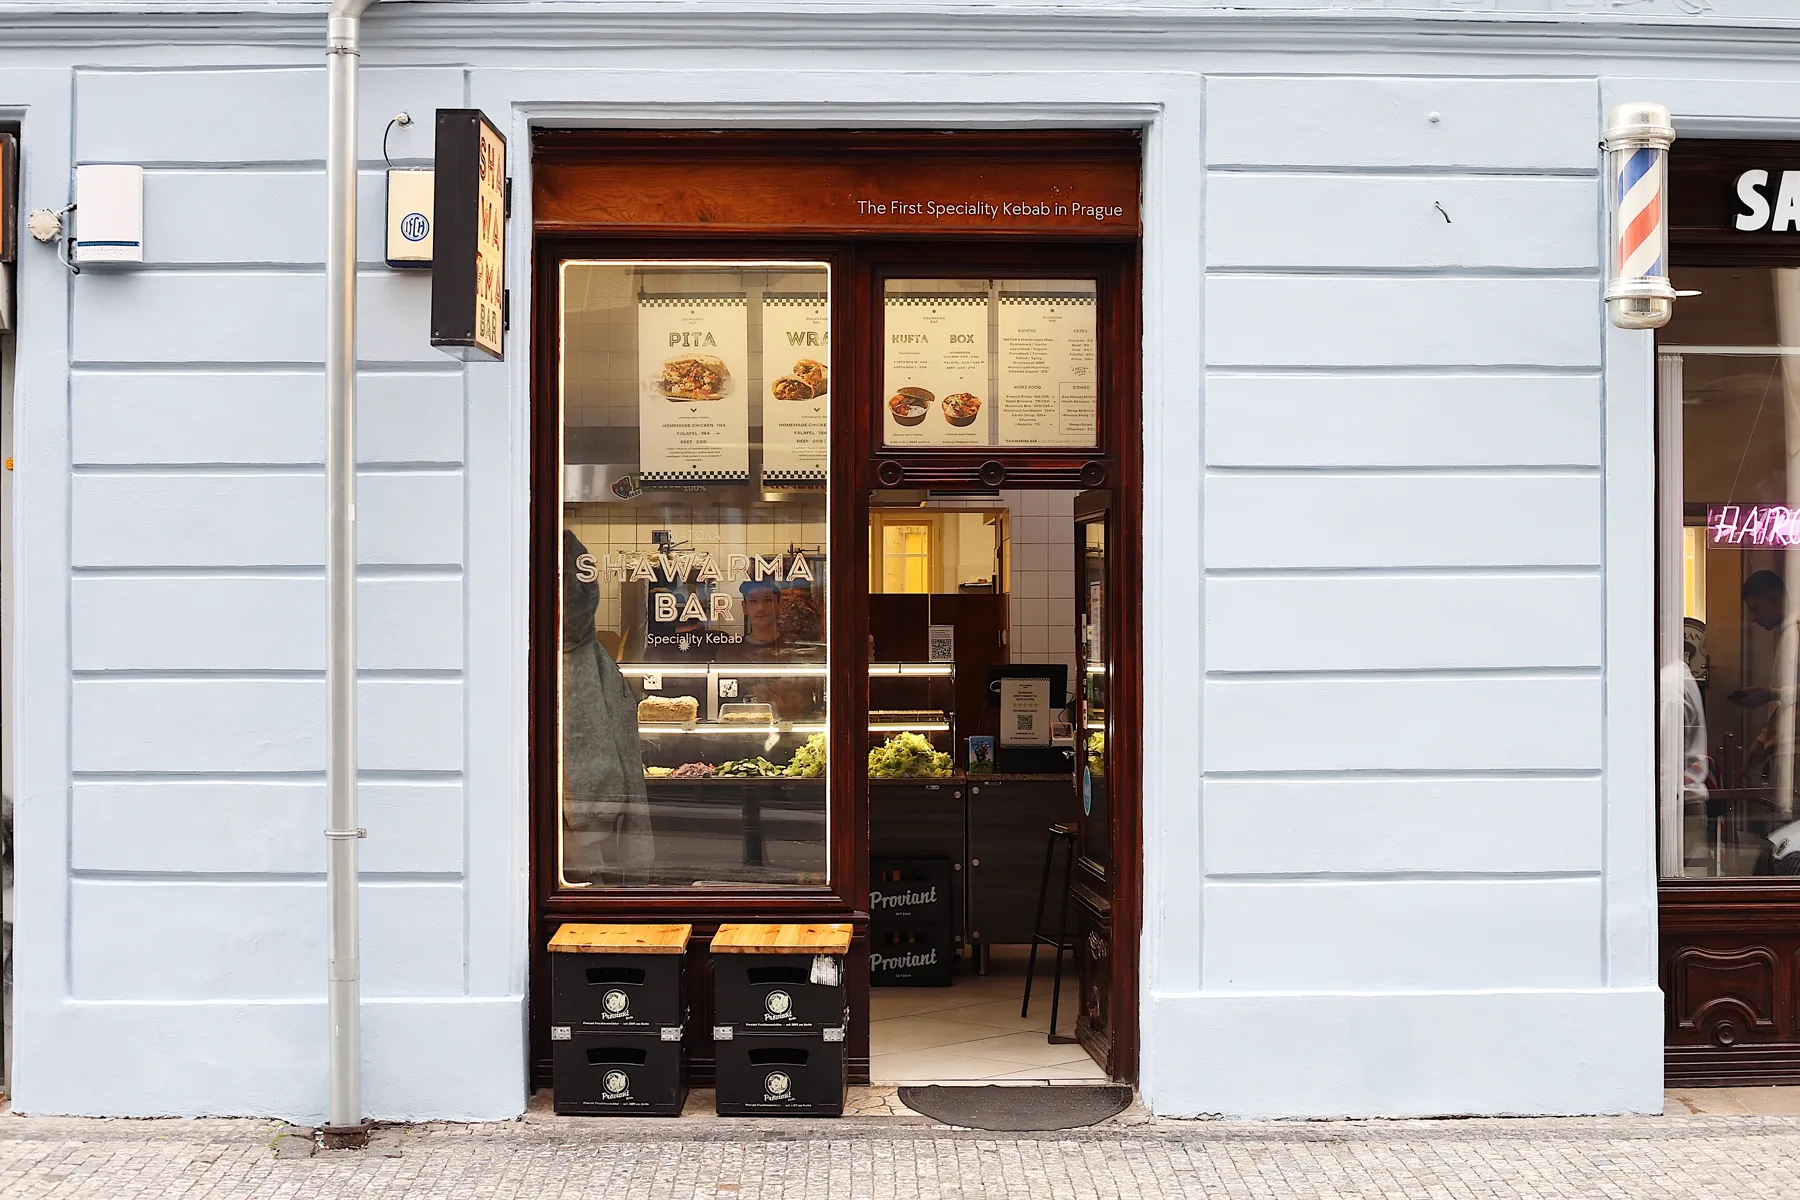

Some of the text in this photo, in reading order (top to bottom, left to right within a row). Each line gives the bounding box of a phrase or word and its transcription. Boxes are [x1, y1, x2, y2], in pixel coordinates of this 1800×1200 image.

[1735, 169, 1800, 232] SA
[857, 200, 1124, 221] The First Speciality Kebab in Prague
[669, 331, 717, 348] PITA
[949, 334, 975, 344] BOX
[575, 552, 815, 583] SHAWARMA
[654, 592, 735, 623] BAR
[647, 633, 743, 647] Speciality Kebab
[869, 886, 938, 910] Proviant
[869, 948, 938, 972] Proviant
[601, 1010, 630, 1020] Proviant
[764, 1011, 793, 1021] Proviant
[602, 1090, 631, 1100] Proviant
[764, 1092, 793, 1102] Proviant
